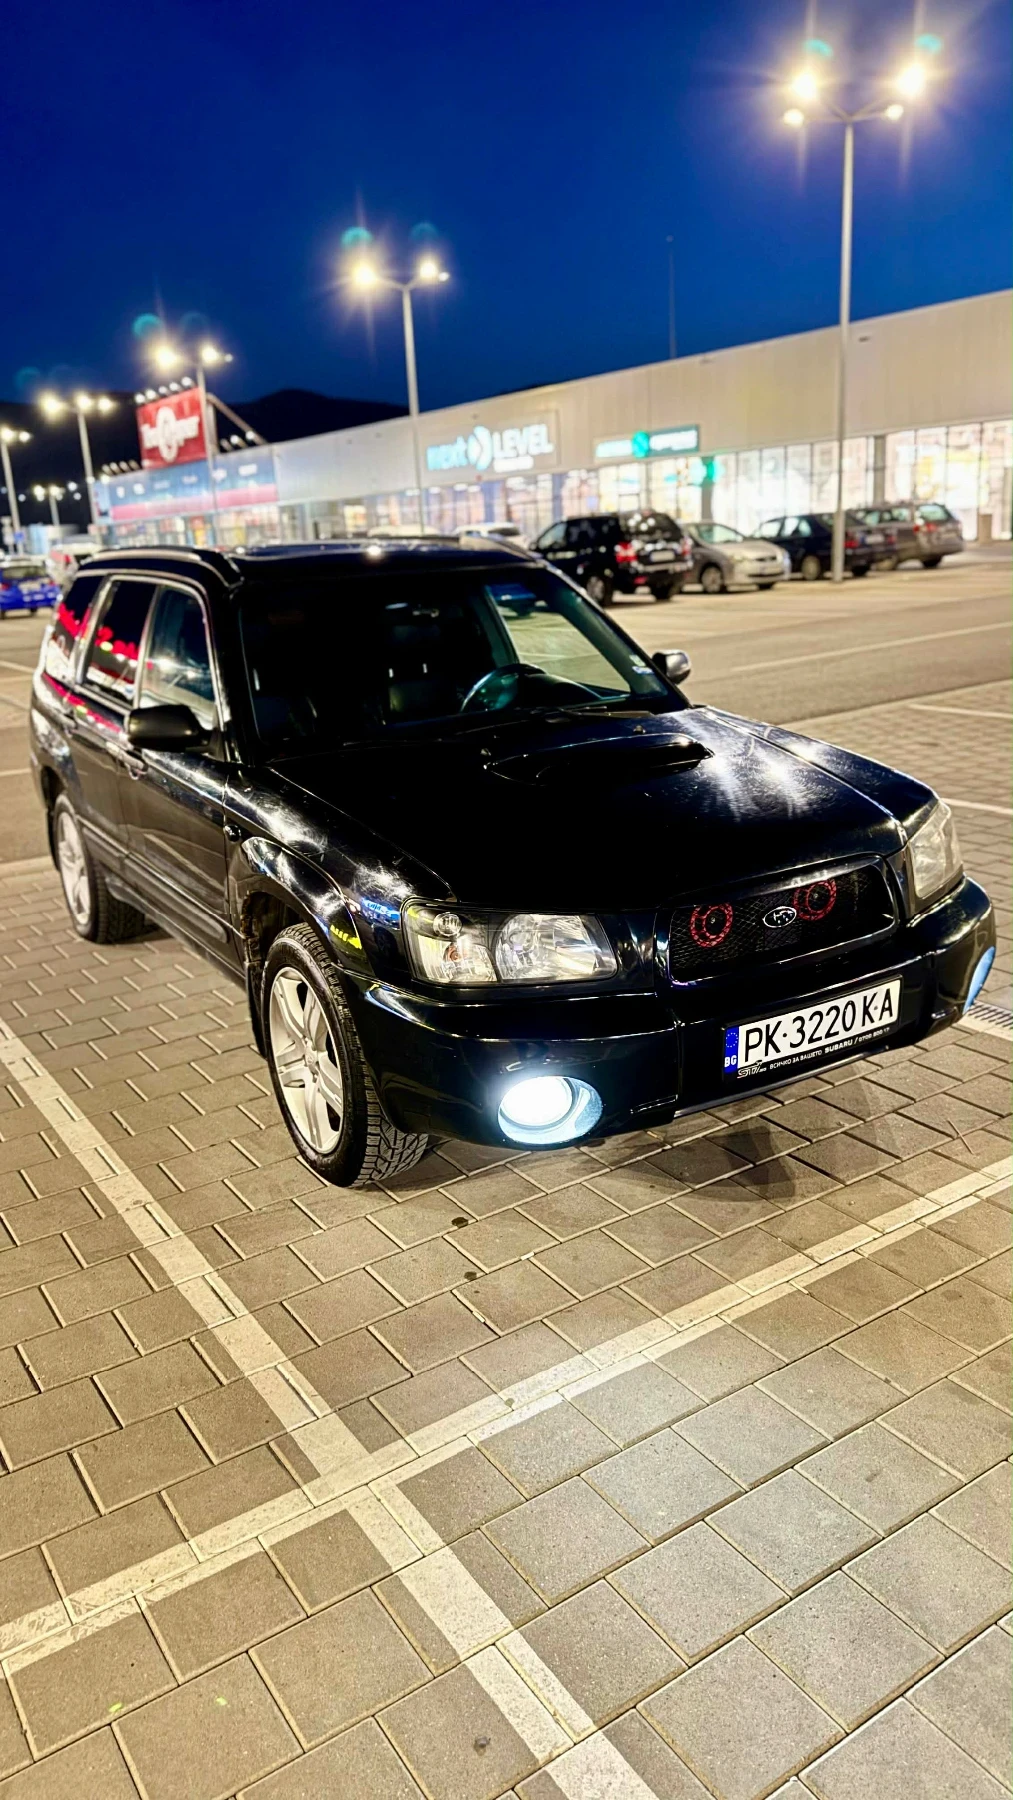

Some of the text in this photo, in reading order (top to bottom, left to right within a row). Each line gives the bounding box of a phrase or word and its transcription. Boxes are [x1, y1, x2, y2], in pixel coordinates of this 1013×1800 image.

[492, 424, 553, 459] LEVEL
[824, 1039, 853, 1054] SUBARU
[724, 1055, 738, 1068] BG
